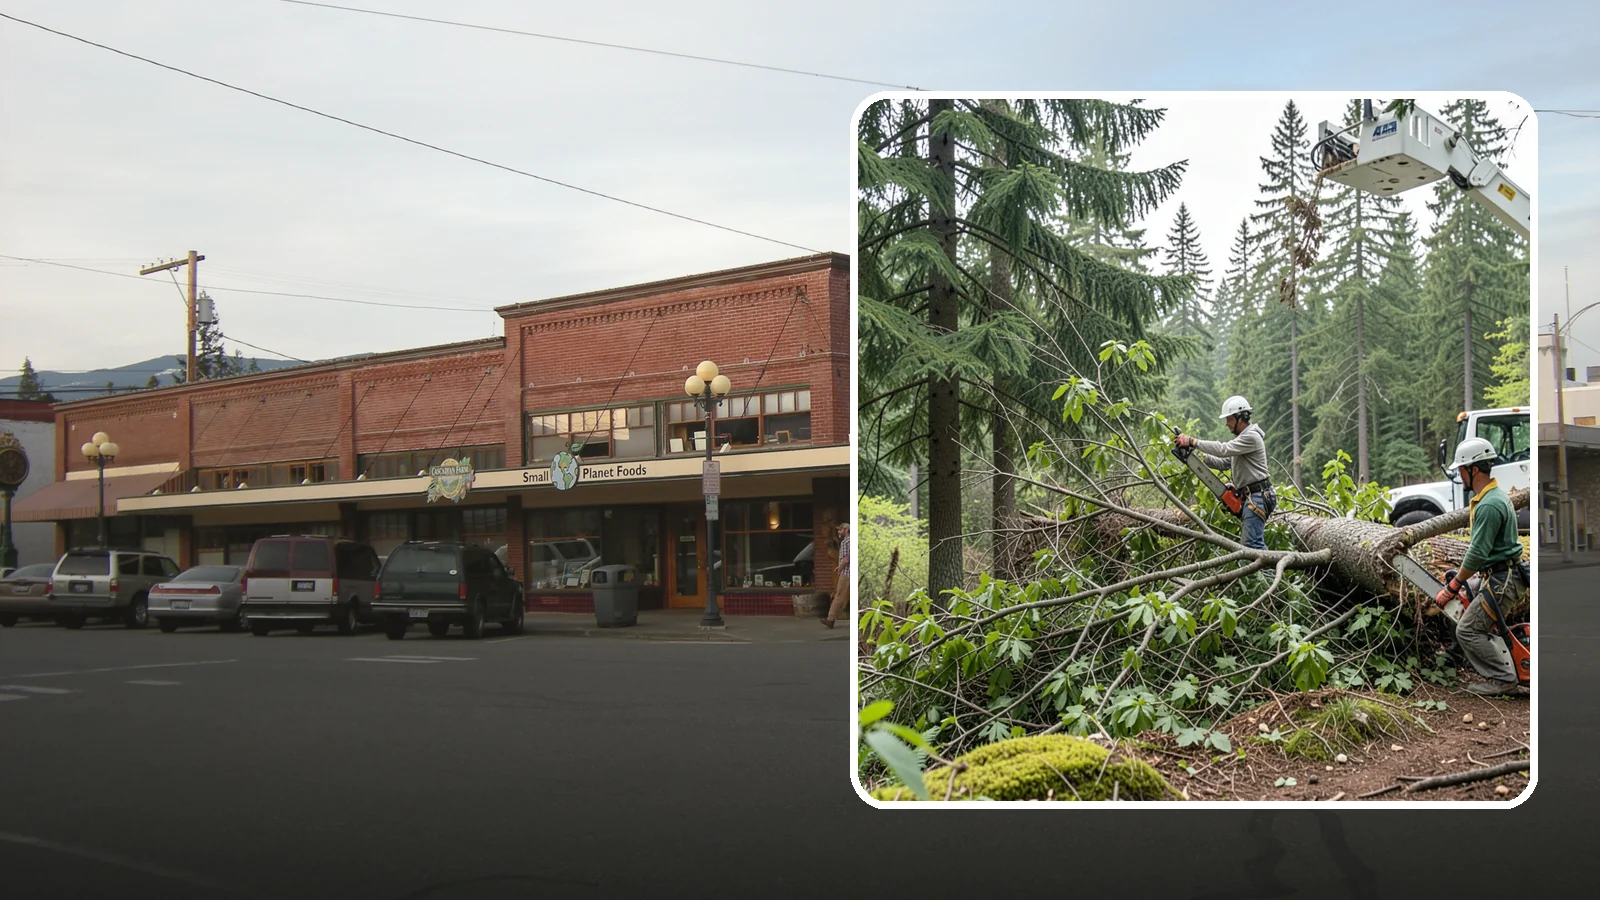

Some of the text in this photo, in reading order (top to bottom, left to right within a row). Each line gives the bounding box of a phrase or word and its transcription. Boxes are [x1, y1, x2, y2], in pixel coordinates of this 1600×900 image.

[456, 466, 469, 474] FARM
[523, 464, 647, 483] Small Planet Foods
